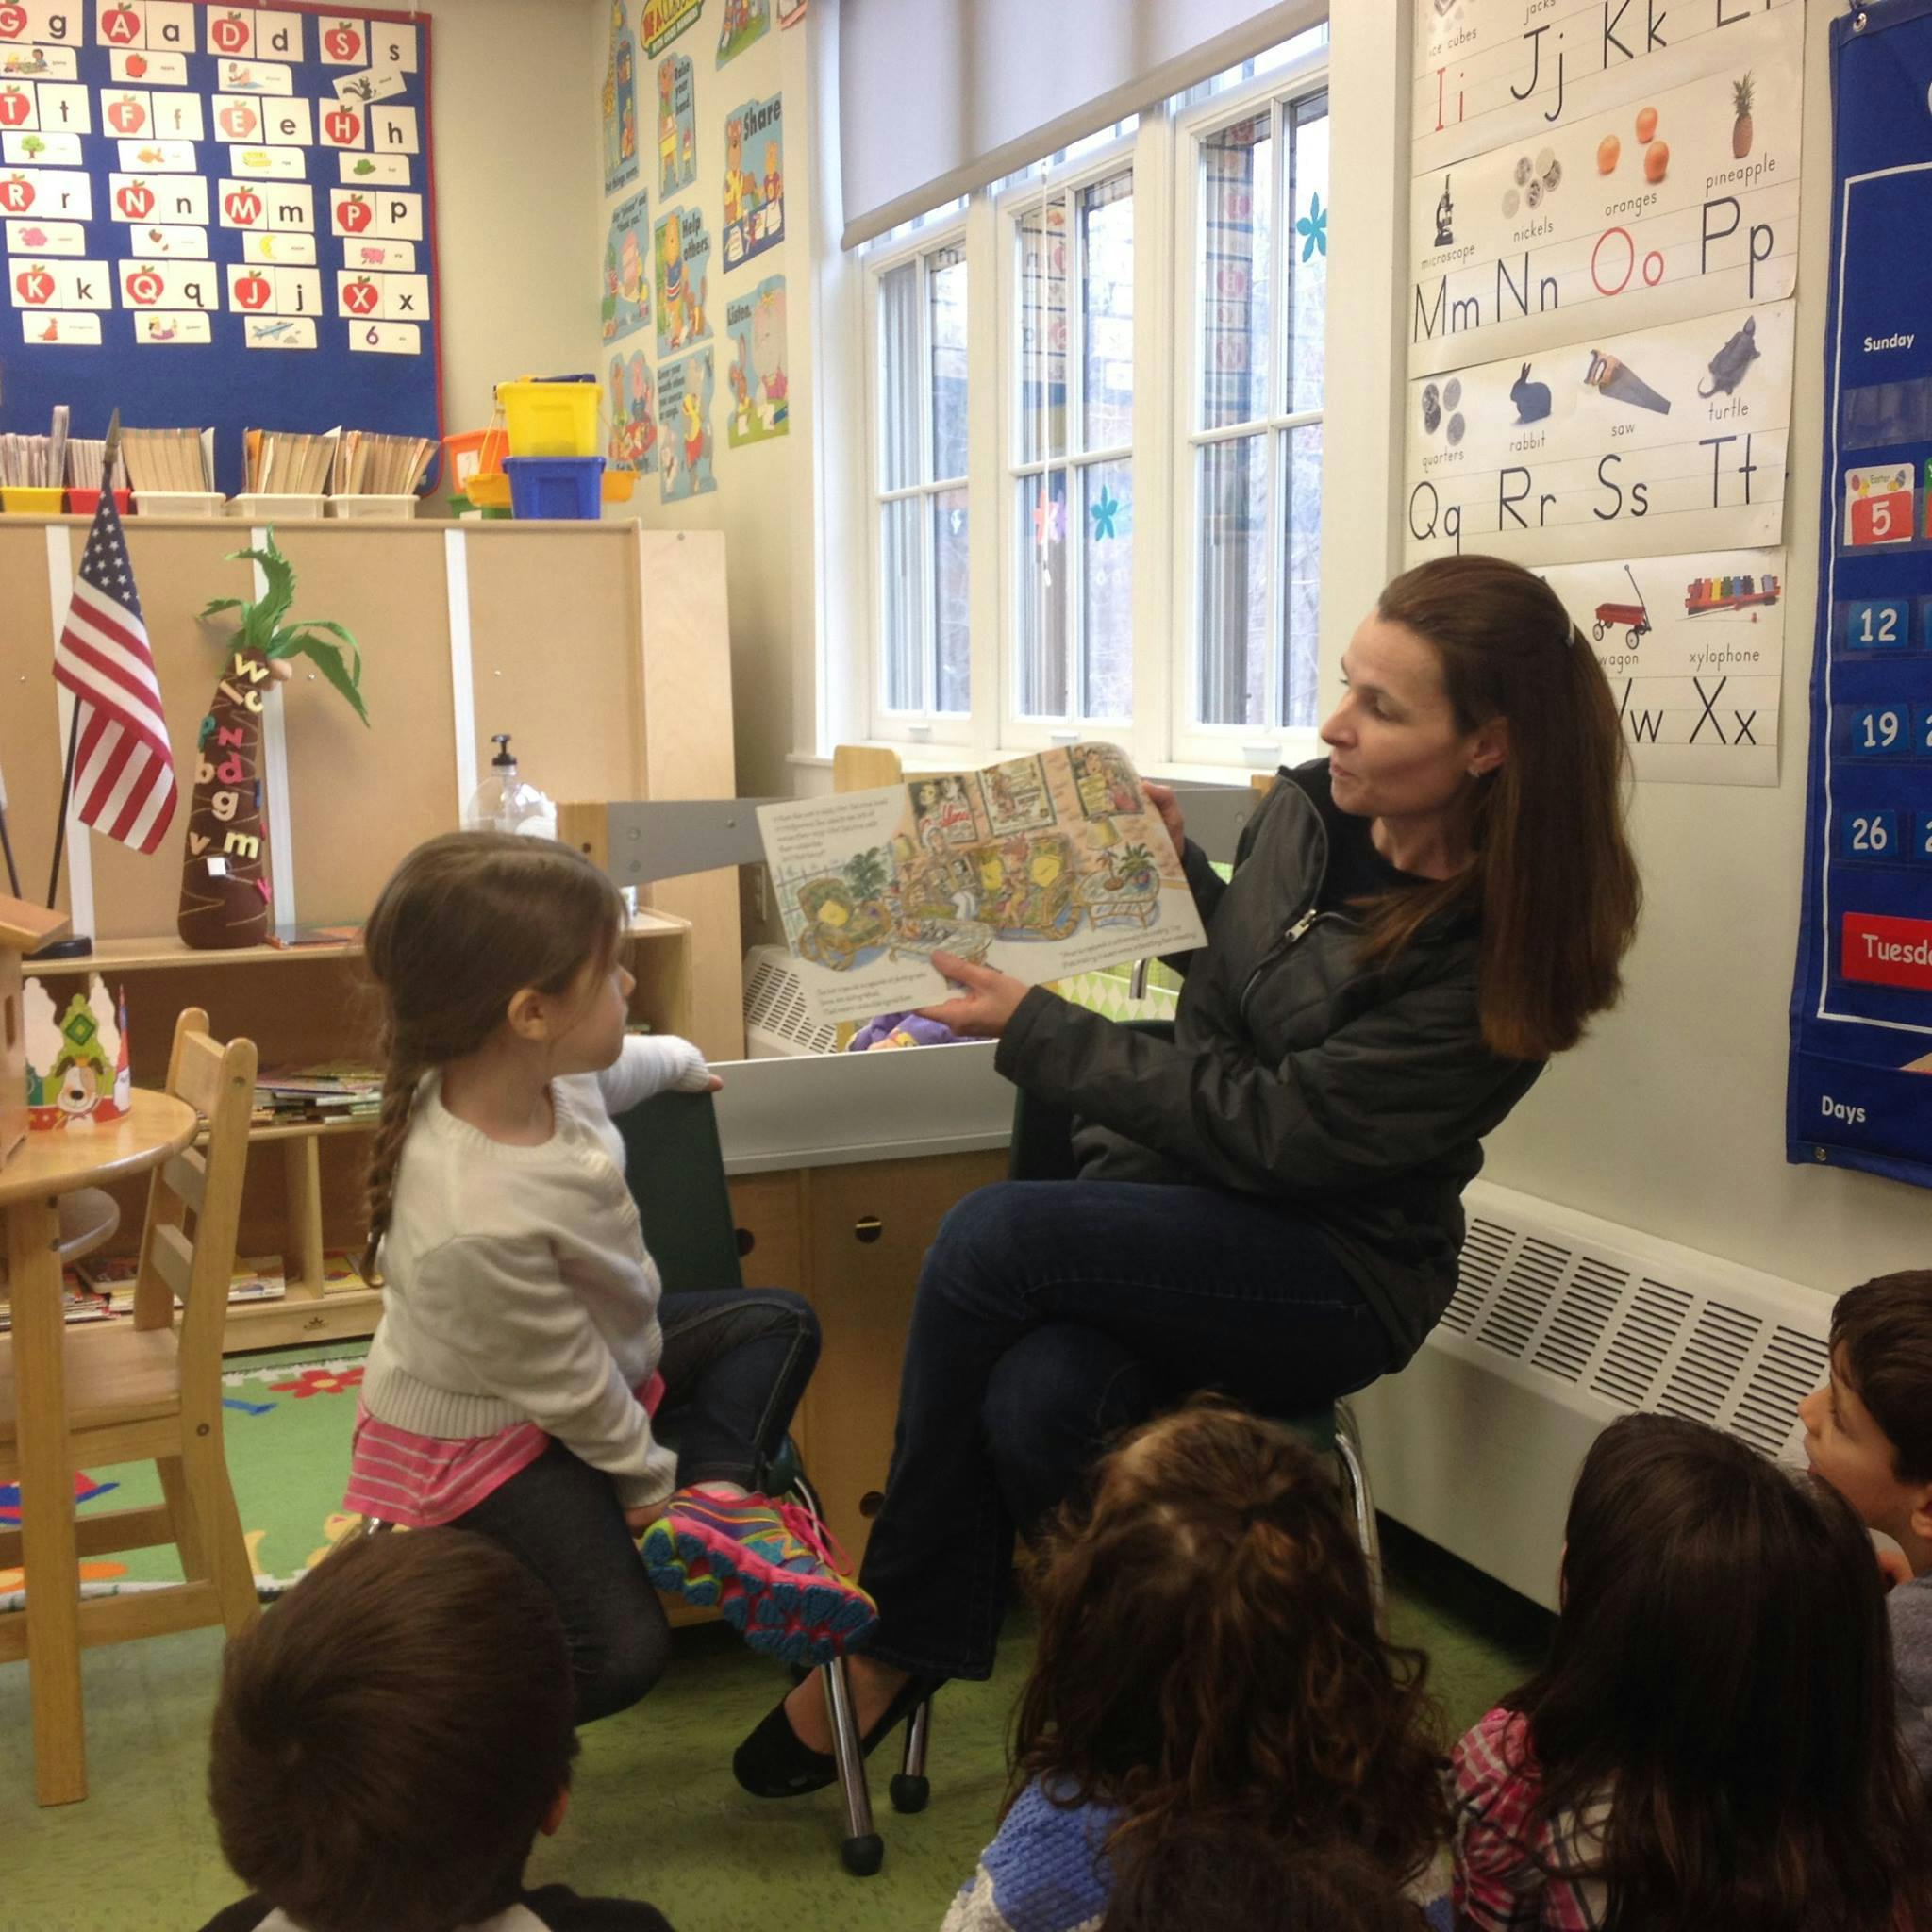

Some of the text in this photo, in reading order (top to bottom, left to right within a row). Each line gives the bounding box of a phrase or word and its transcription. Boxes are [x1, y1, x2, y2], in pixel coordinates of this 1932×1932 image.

[0, 8, 67, 39] G g
[110, 13, 180, 42] A a
[222, 23, 289, 52] D d
[336, 32, 400, 61] S s
[1448, 27, 1477, 48] cubes
[4, 97, 69, 122] T t
[121, 105, 182, 130] F f
[231, 110, 296, 135] E e
[744, 100, 781, 141] Share
[334, 115, 403, 143] H h
[1706, 152, 1775, 197] pineapple
[8, 184, 71, 208] R r
[125, 189, 192, 214] N n
[230, 196, 303, 223] M m
[1606, 192, 1657, 217] oranges
[347, 201, 408, 227] P p
[682, 213, 700, 238] Help
[1513, 215, 1554, 242] nickels
[1421, 243, 1475, 270] microscope
[27, 275, 93, 300] K k
[133, 275, 204, 308] Q q
[246, 281, 304, 311] J j
[352, 286, 414, 311] X x
[366, 326, 379, 345] 6
[1864, 333, 1915, 353] Sunday
[1708, 397, 1749, 421] turtle
[1509, 430, 1546, 452] rabbit
[1611, 424, 1636, 436] saw
[1422, 446, 1464, 474] quarters
[1872, 501, 1890, 536] 5
[1860, 608, 1898, 642] 12
[1690, 643, 1760, 672] xylophone
[1862, 711, 1898, 748] 19
[212, 791, 239, 822] g
[224, 831, 259, 859] m
[1852, 816, 1888, 850] 26
[1822, 1095, 1866, 1125] Days
